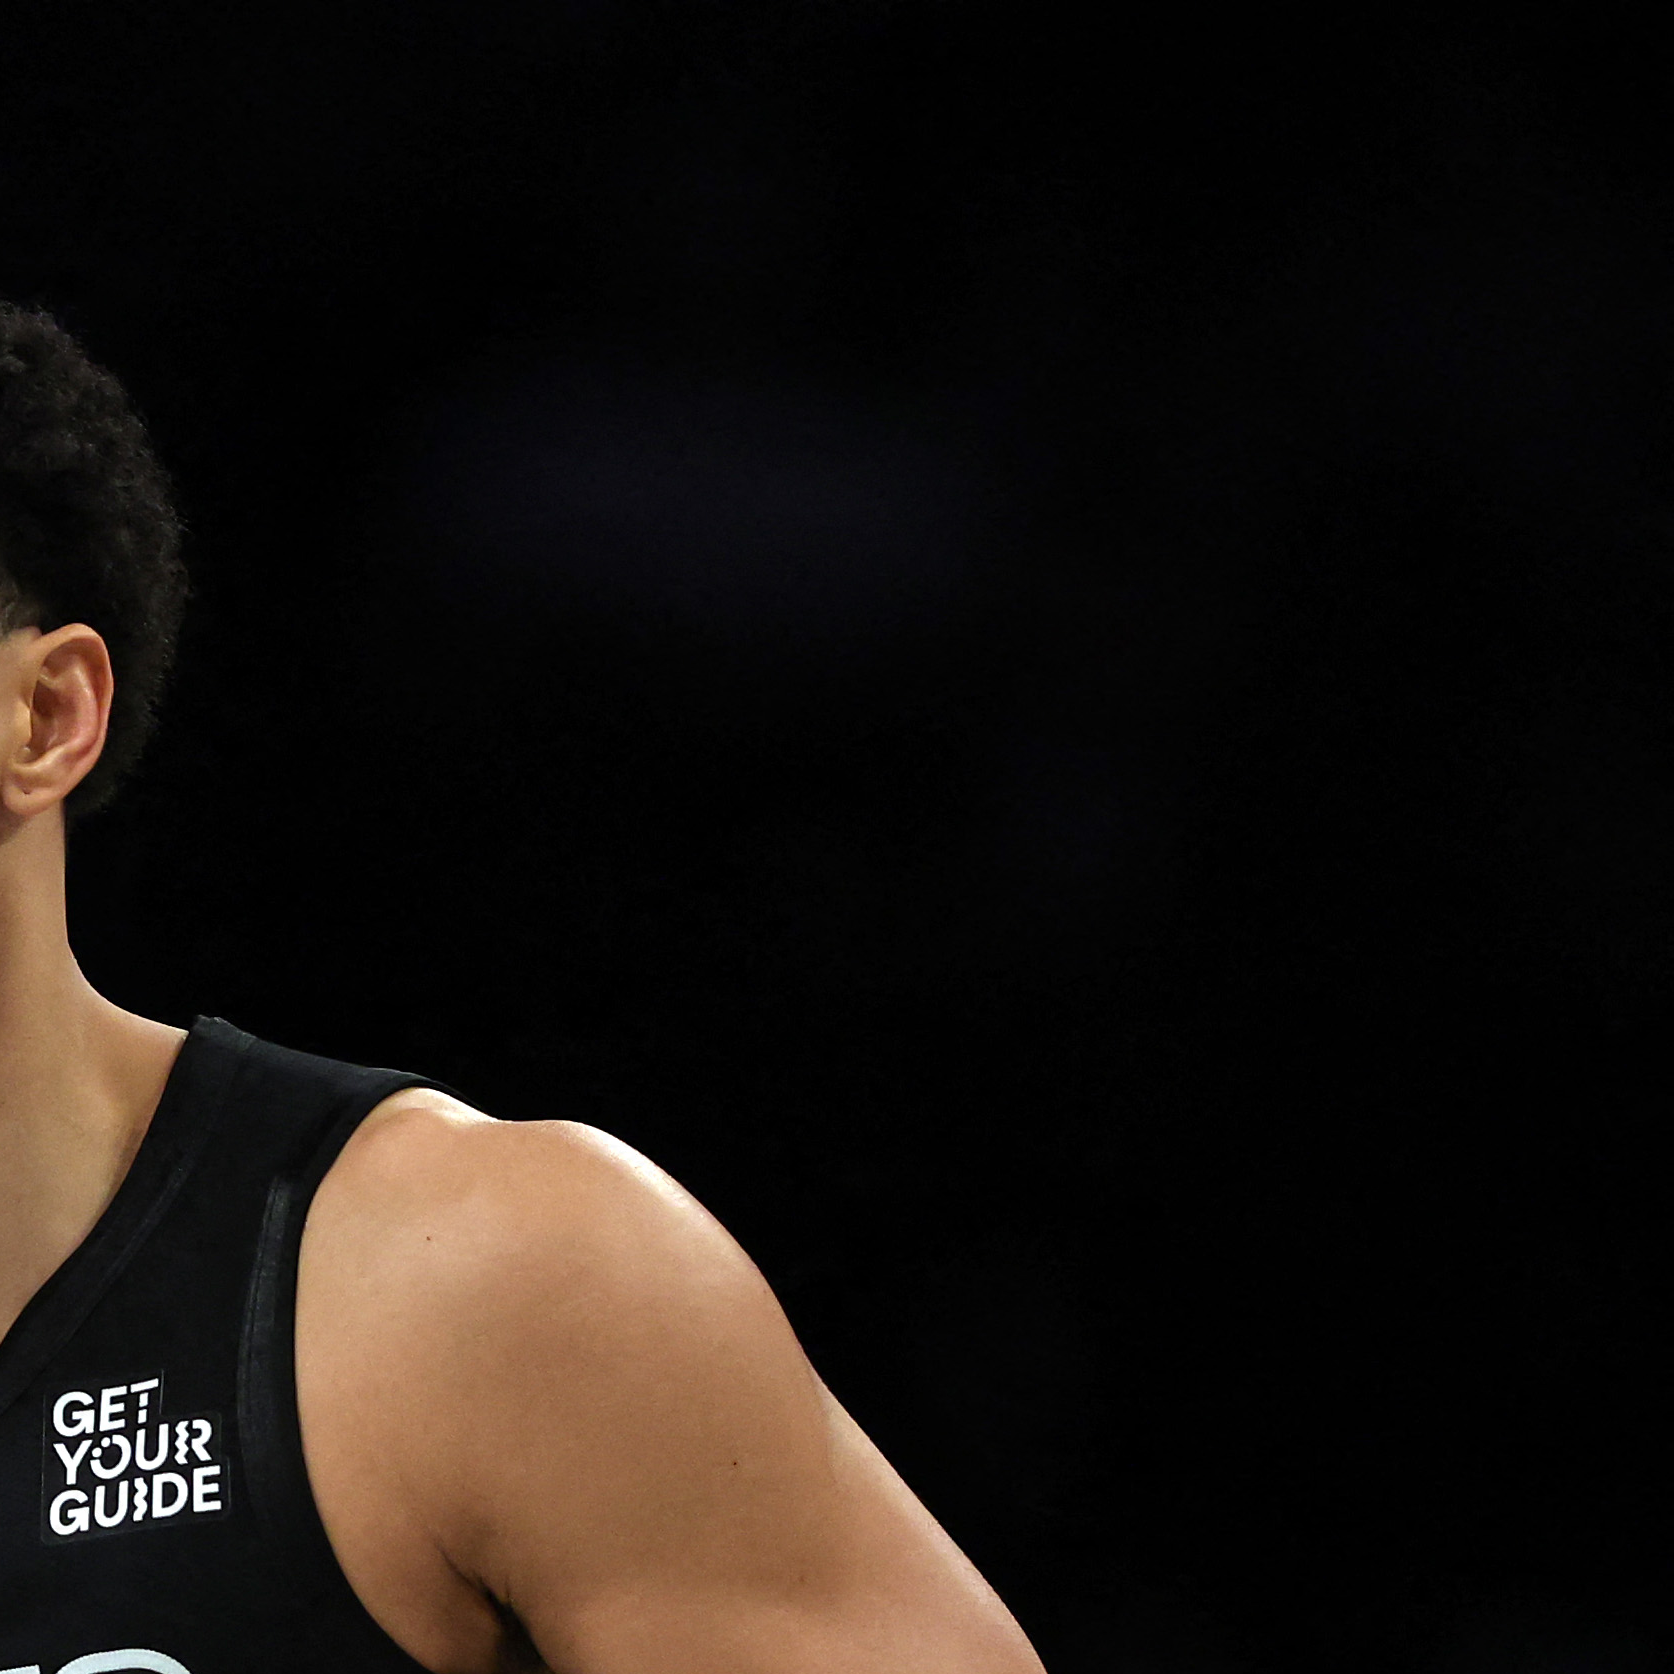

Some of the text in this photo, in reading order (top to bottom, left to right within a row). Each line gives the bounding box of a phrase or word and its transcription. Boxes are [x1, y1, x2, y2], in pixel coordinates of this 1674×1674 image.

[53, 1378, 159, 1437] GET
[53, 1419, 213, 1486] YOUR
[49, 1465, 223, 1536] GUIDE
